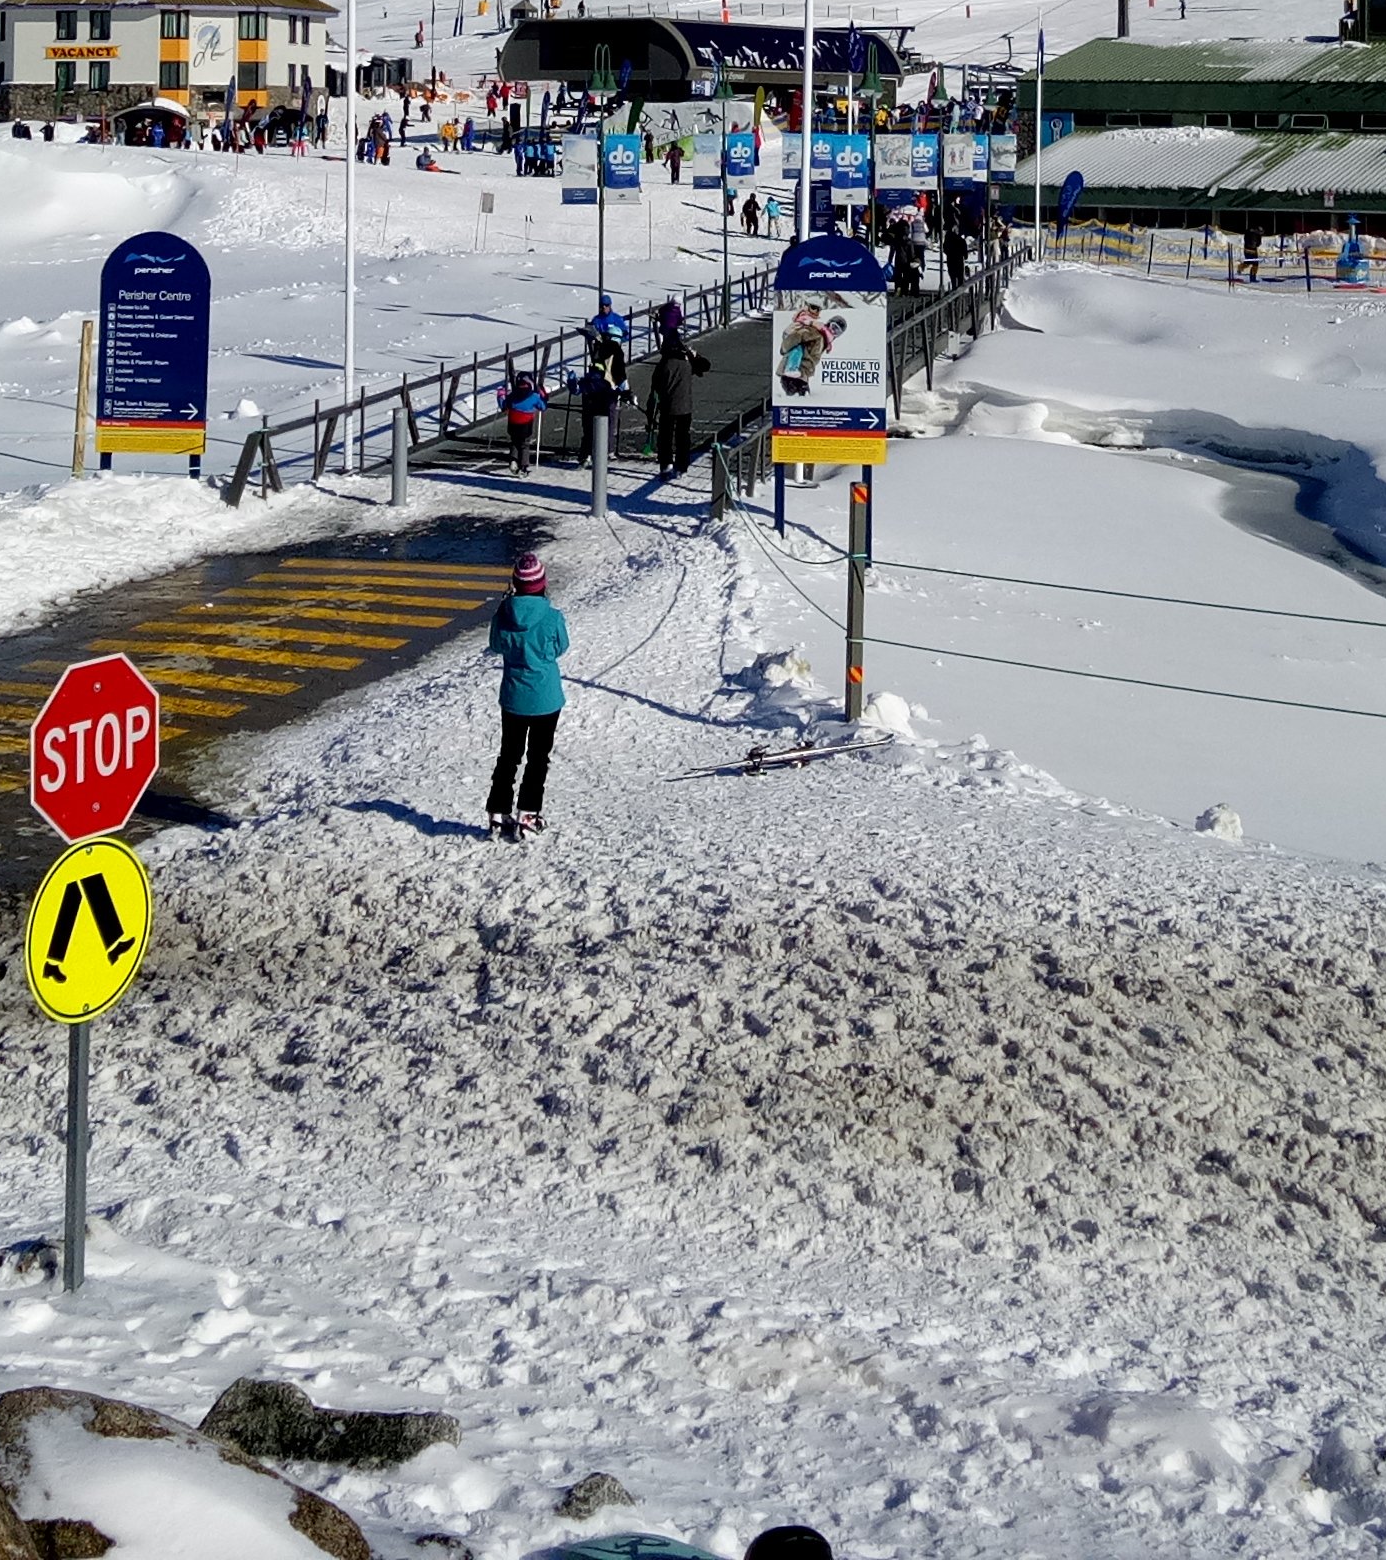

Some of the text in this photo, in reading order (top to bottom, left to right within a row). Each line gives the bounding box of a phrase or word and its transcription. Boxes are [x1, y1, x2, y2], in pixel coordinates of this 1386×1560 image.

[50, 47, 113, 57] VACANCY
[730, 142, 751, 158] do
[813, 140, 830, 153] do
[913, 142, 933, 157] do
[609, 144, 634, 164] do
[836, 145, 863, 166] do
[134, 267, 175, 275] perisher
[809, 271, 851, 279] perisher
[118, 290, 191, 301] Perisher Centre
[821, 361, 880, 371] WELCOME TO
[821, 371, 880, 384] PERISHER
[40, 705, 151, 794] STOP
